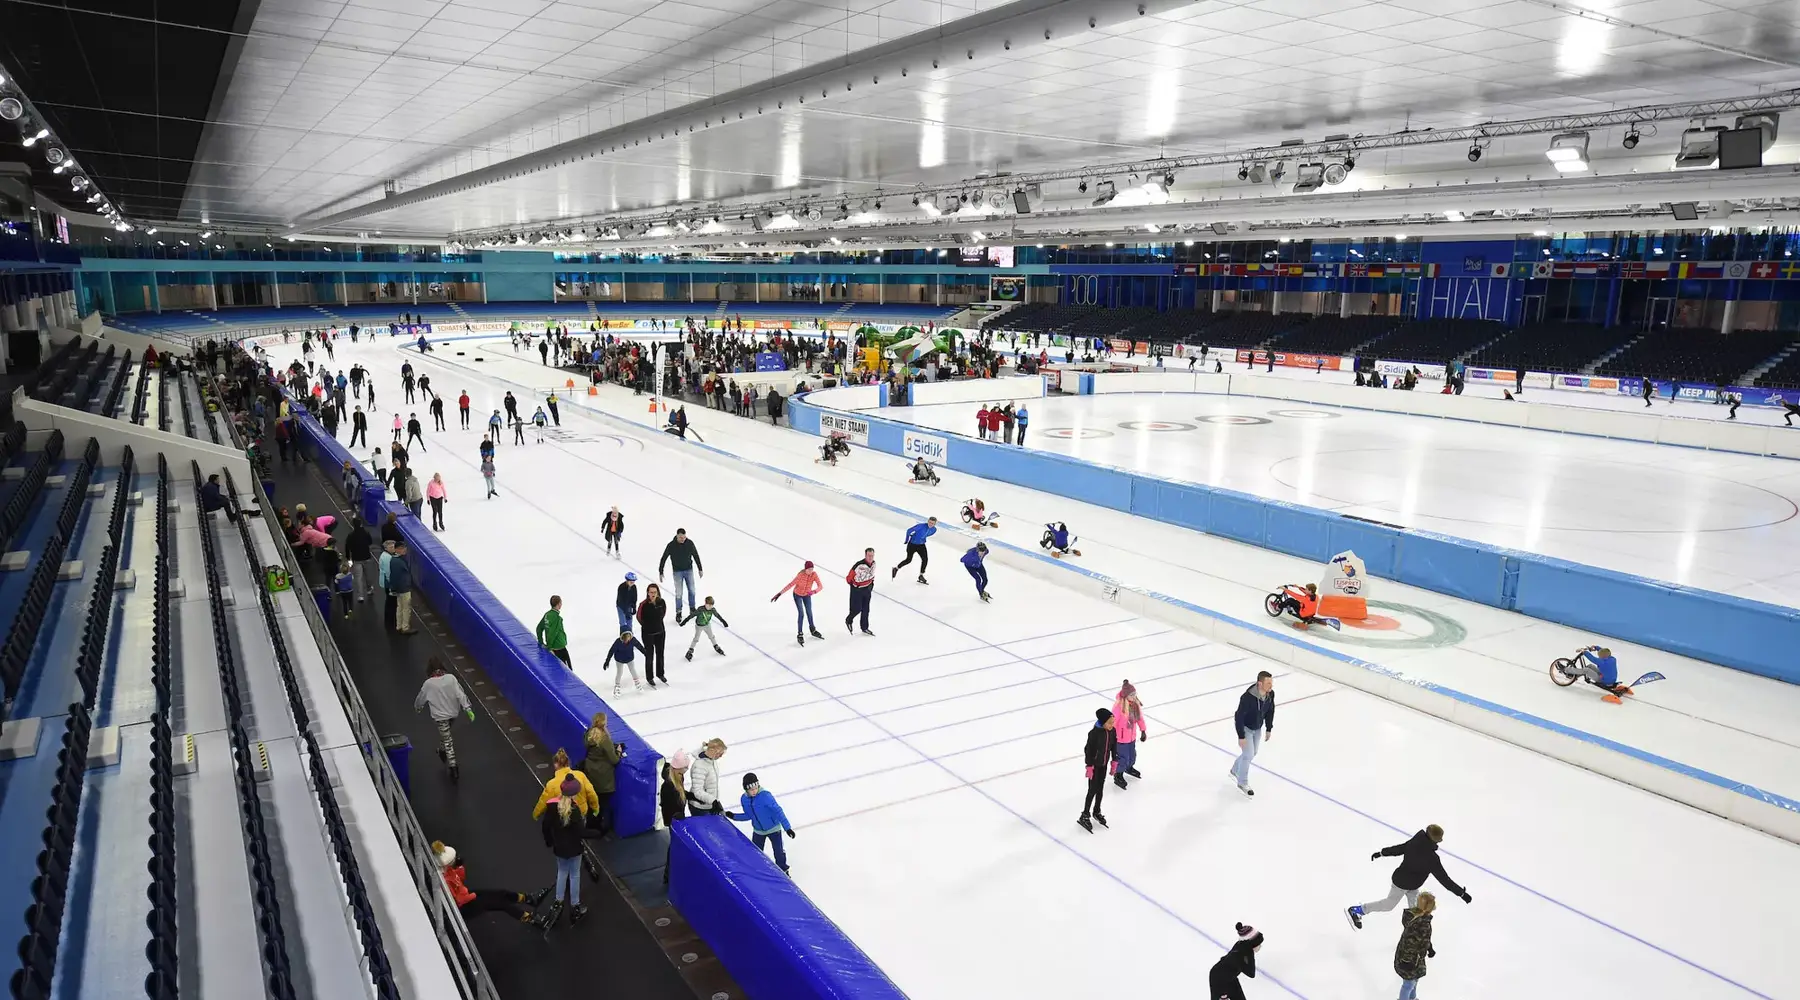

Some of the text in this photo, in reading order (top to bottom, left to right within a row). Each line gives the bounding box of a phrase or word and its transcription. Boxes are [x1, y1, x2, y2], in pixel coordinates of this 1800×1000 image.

[1679, 387, 1703, 397] KEEP
[821, 414, 868, 435] HIER NIET STAAN!
[914, 439, 943, 458] Sidijk
